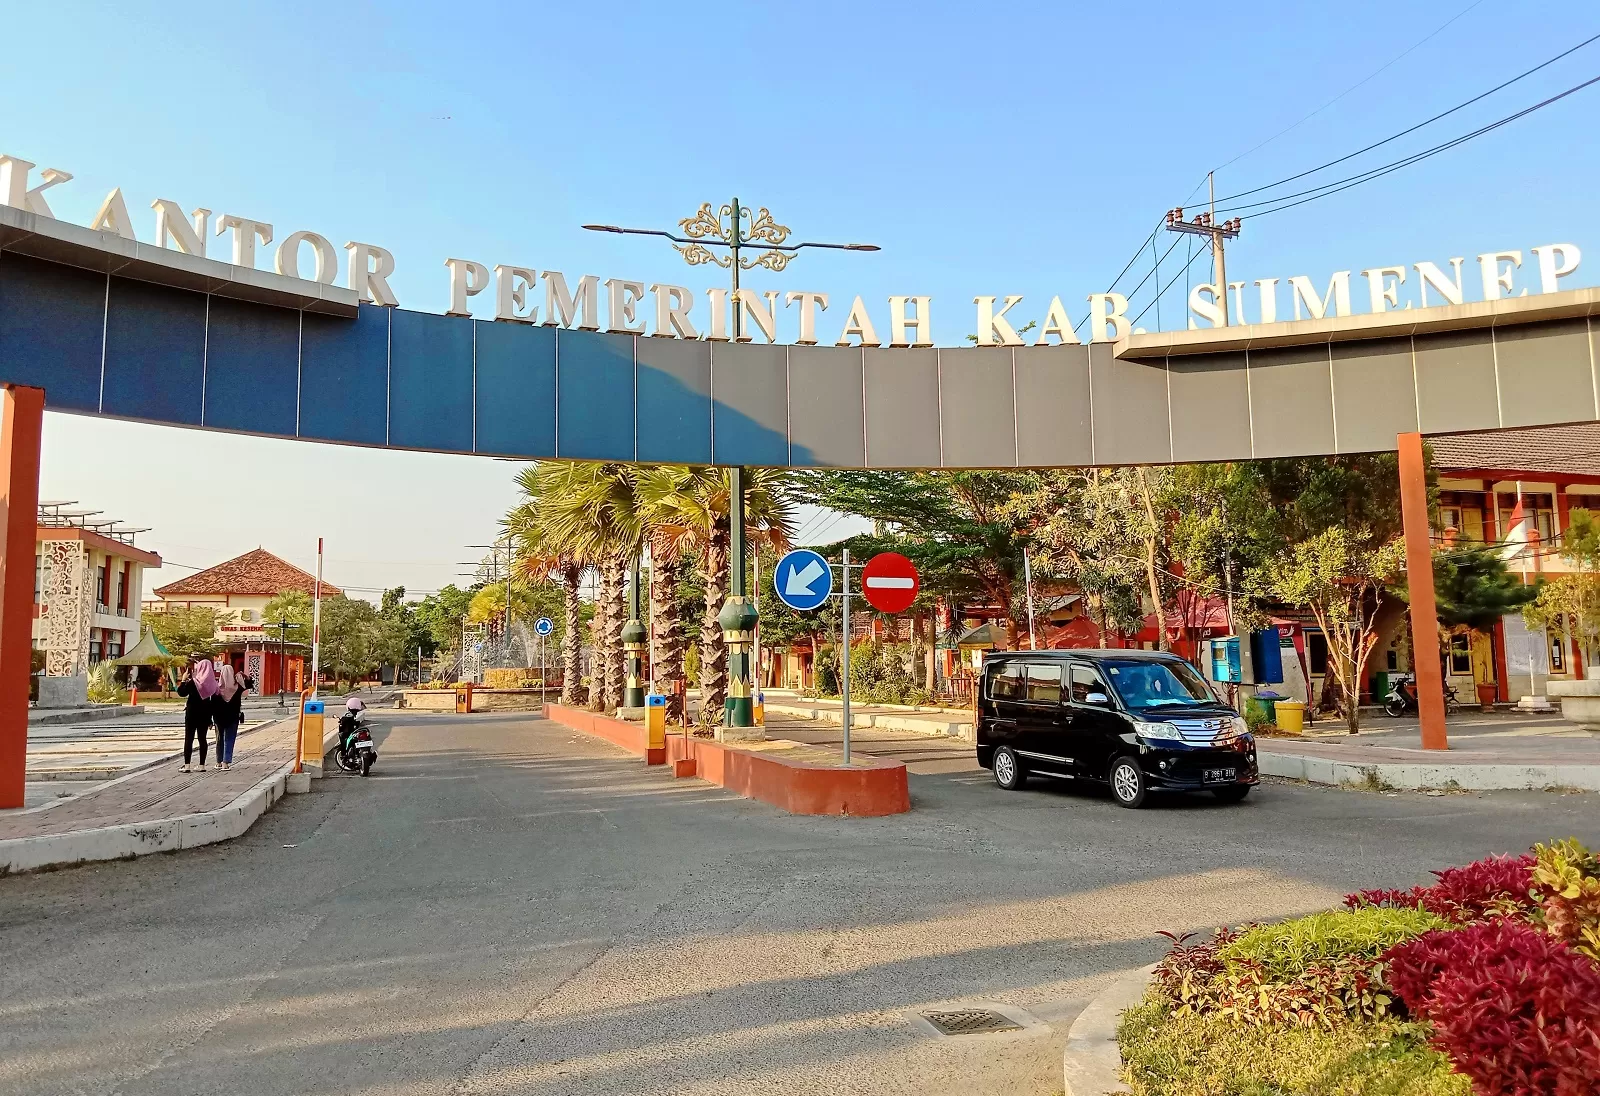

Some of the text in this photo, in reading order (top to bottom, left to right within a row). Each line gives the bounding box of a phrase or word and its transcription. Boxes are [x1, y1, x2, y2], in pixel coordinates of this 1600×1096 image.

[0, 154, 1582, 348] KANTOR PEMERINTAH KAB. SUMENEP
